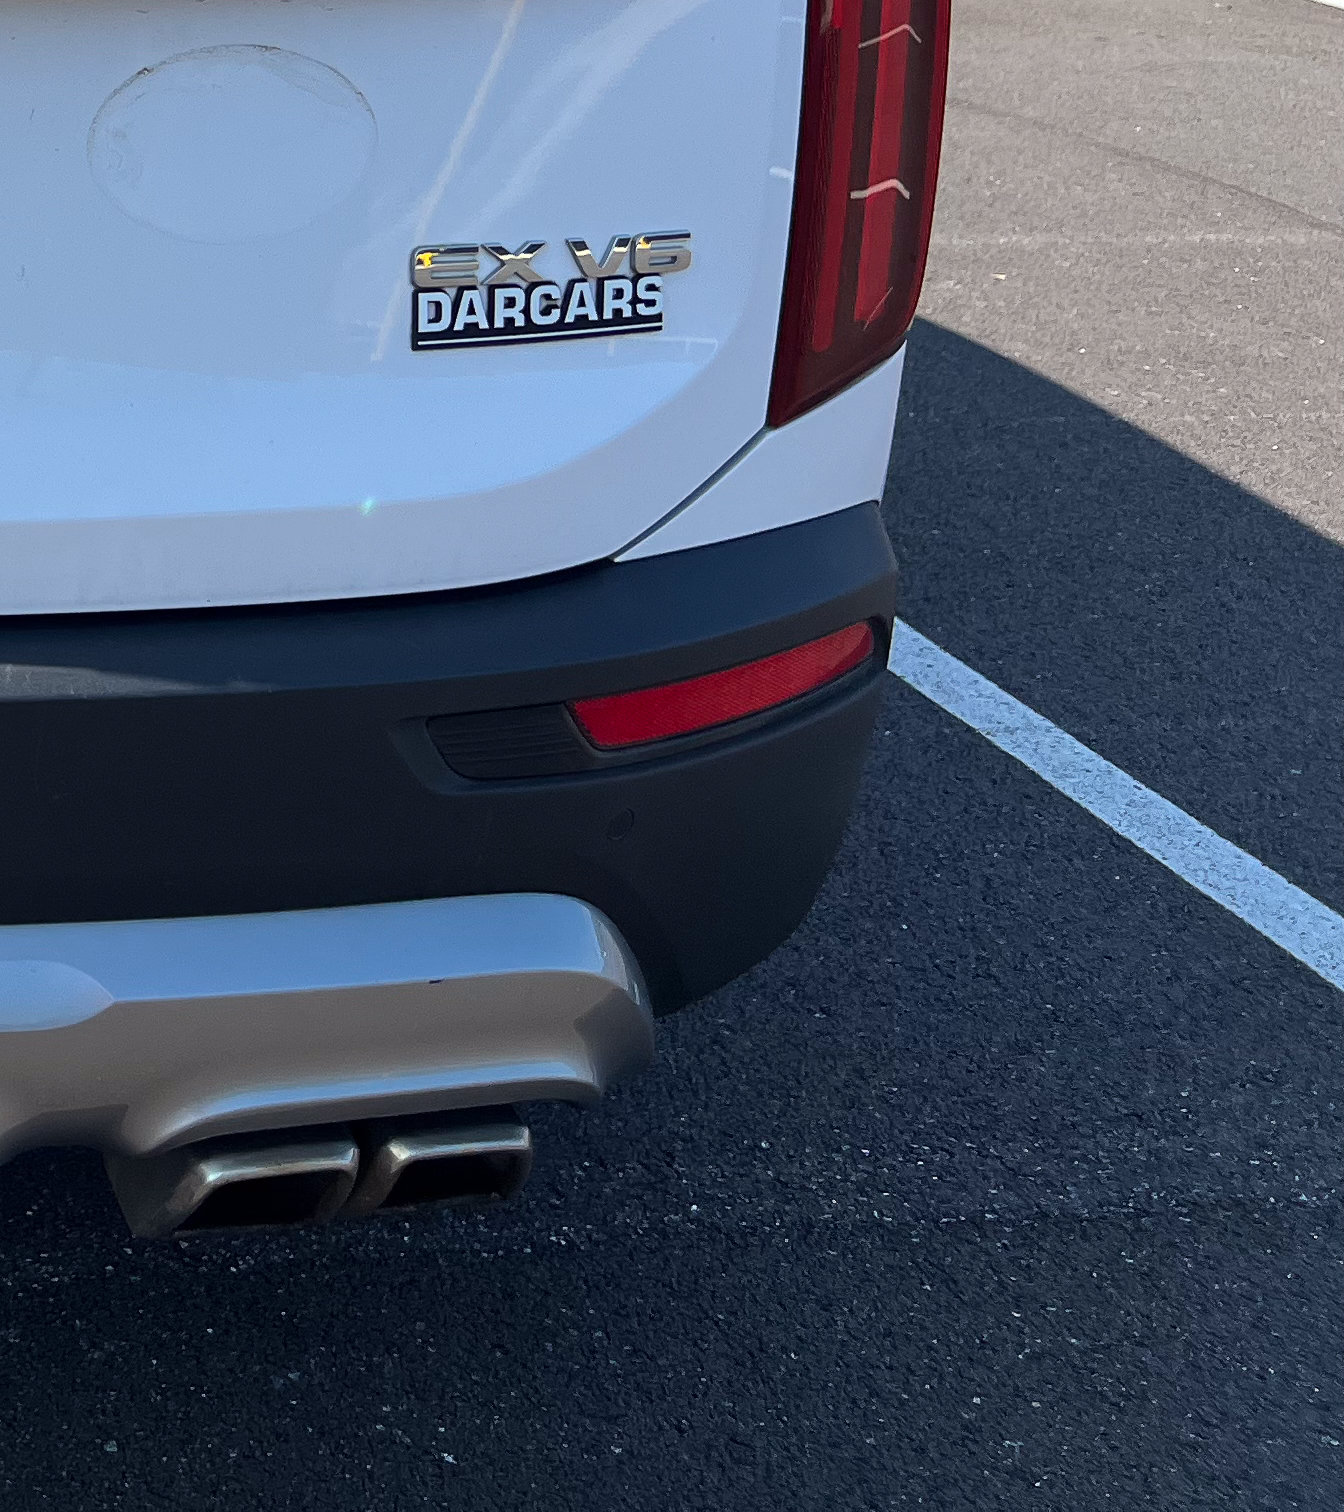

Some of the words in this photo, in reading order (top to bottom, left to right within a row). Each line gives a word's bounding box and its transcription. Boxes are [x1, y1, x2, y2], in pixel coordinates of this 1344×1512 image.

[412, 242, 546, 287] EX
[566, 229, 692, 278] V6
[417, 275, 662, 334] DARCARS
